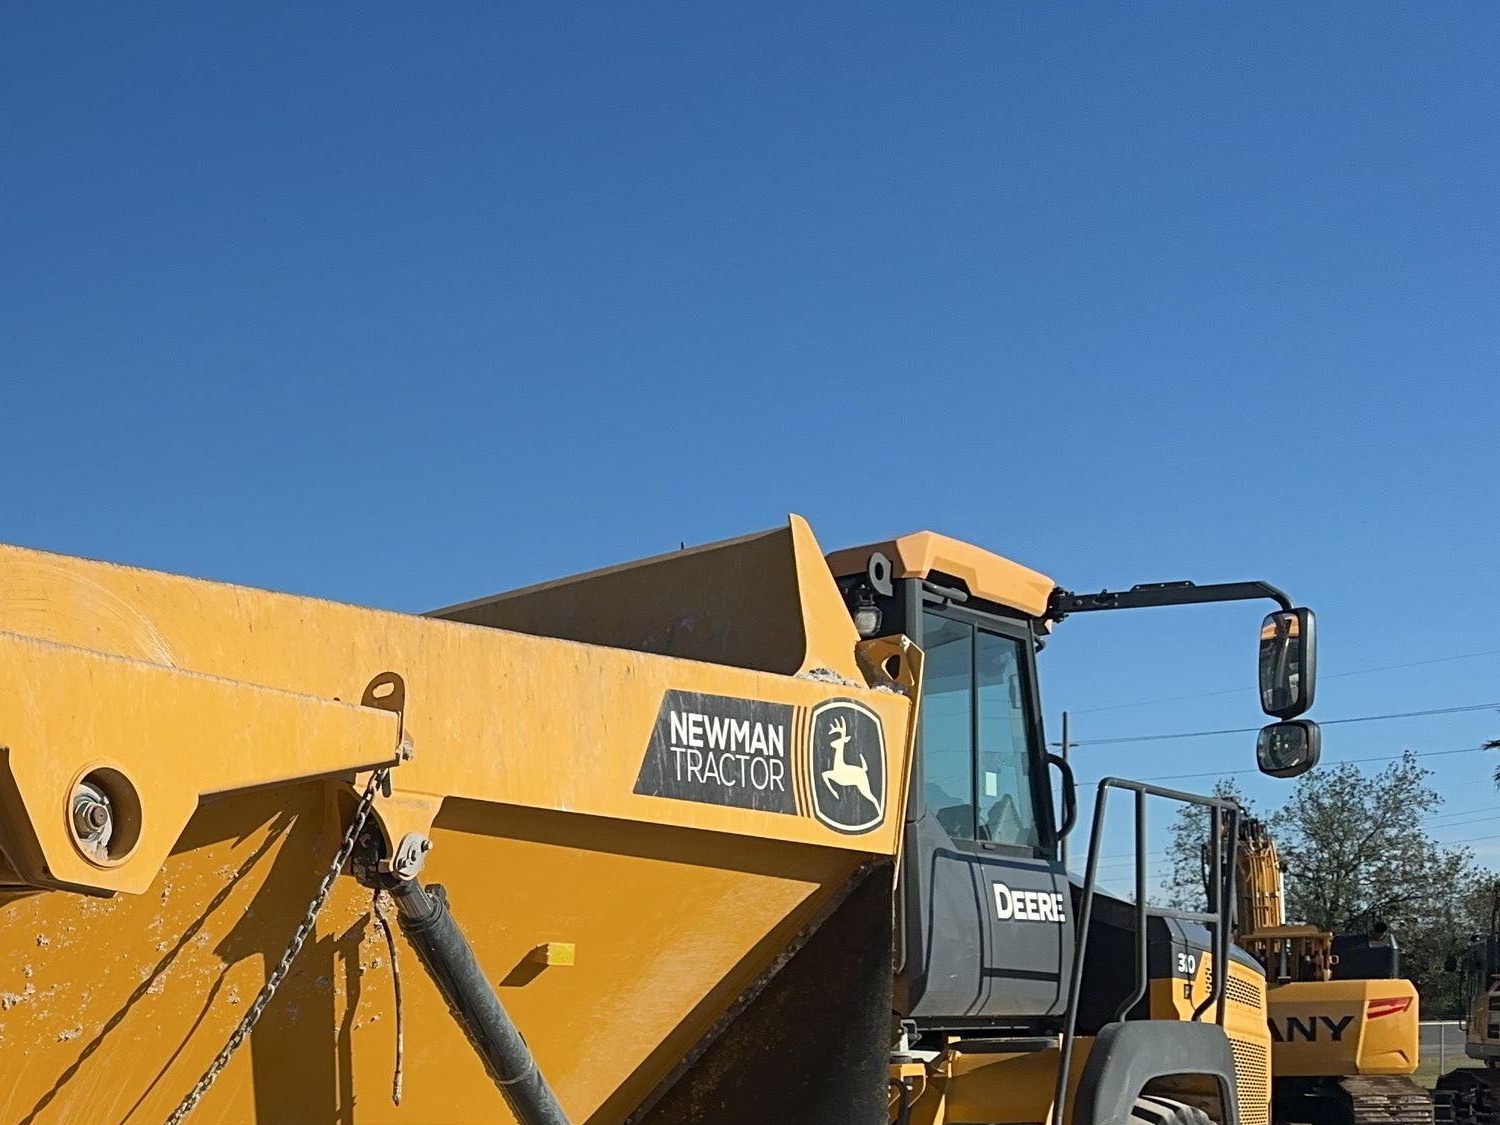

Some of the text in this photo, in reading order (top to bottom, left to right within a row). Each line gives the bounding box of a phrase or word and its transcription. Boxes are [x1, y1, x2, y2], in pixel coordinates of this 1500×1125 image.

[670, 710, 784, 757] NEWMAN
[670, 746, 785, 791] TRACTOR
[993, 883, 1066, 922] DEERE
